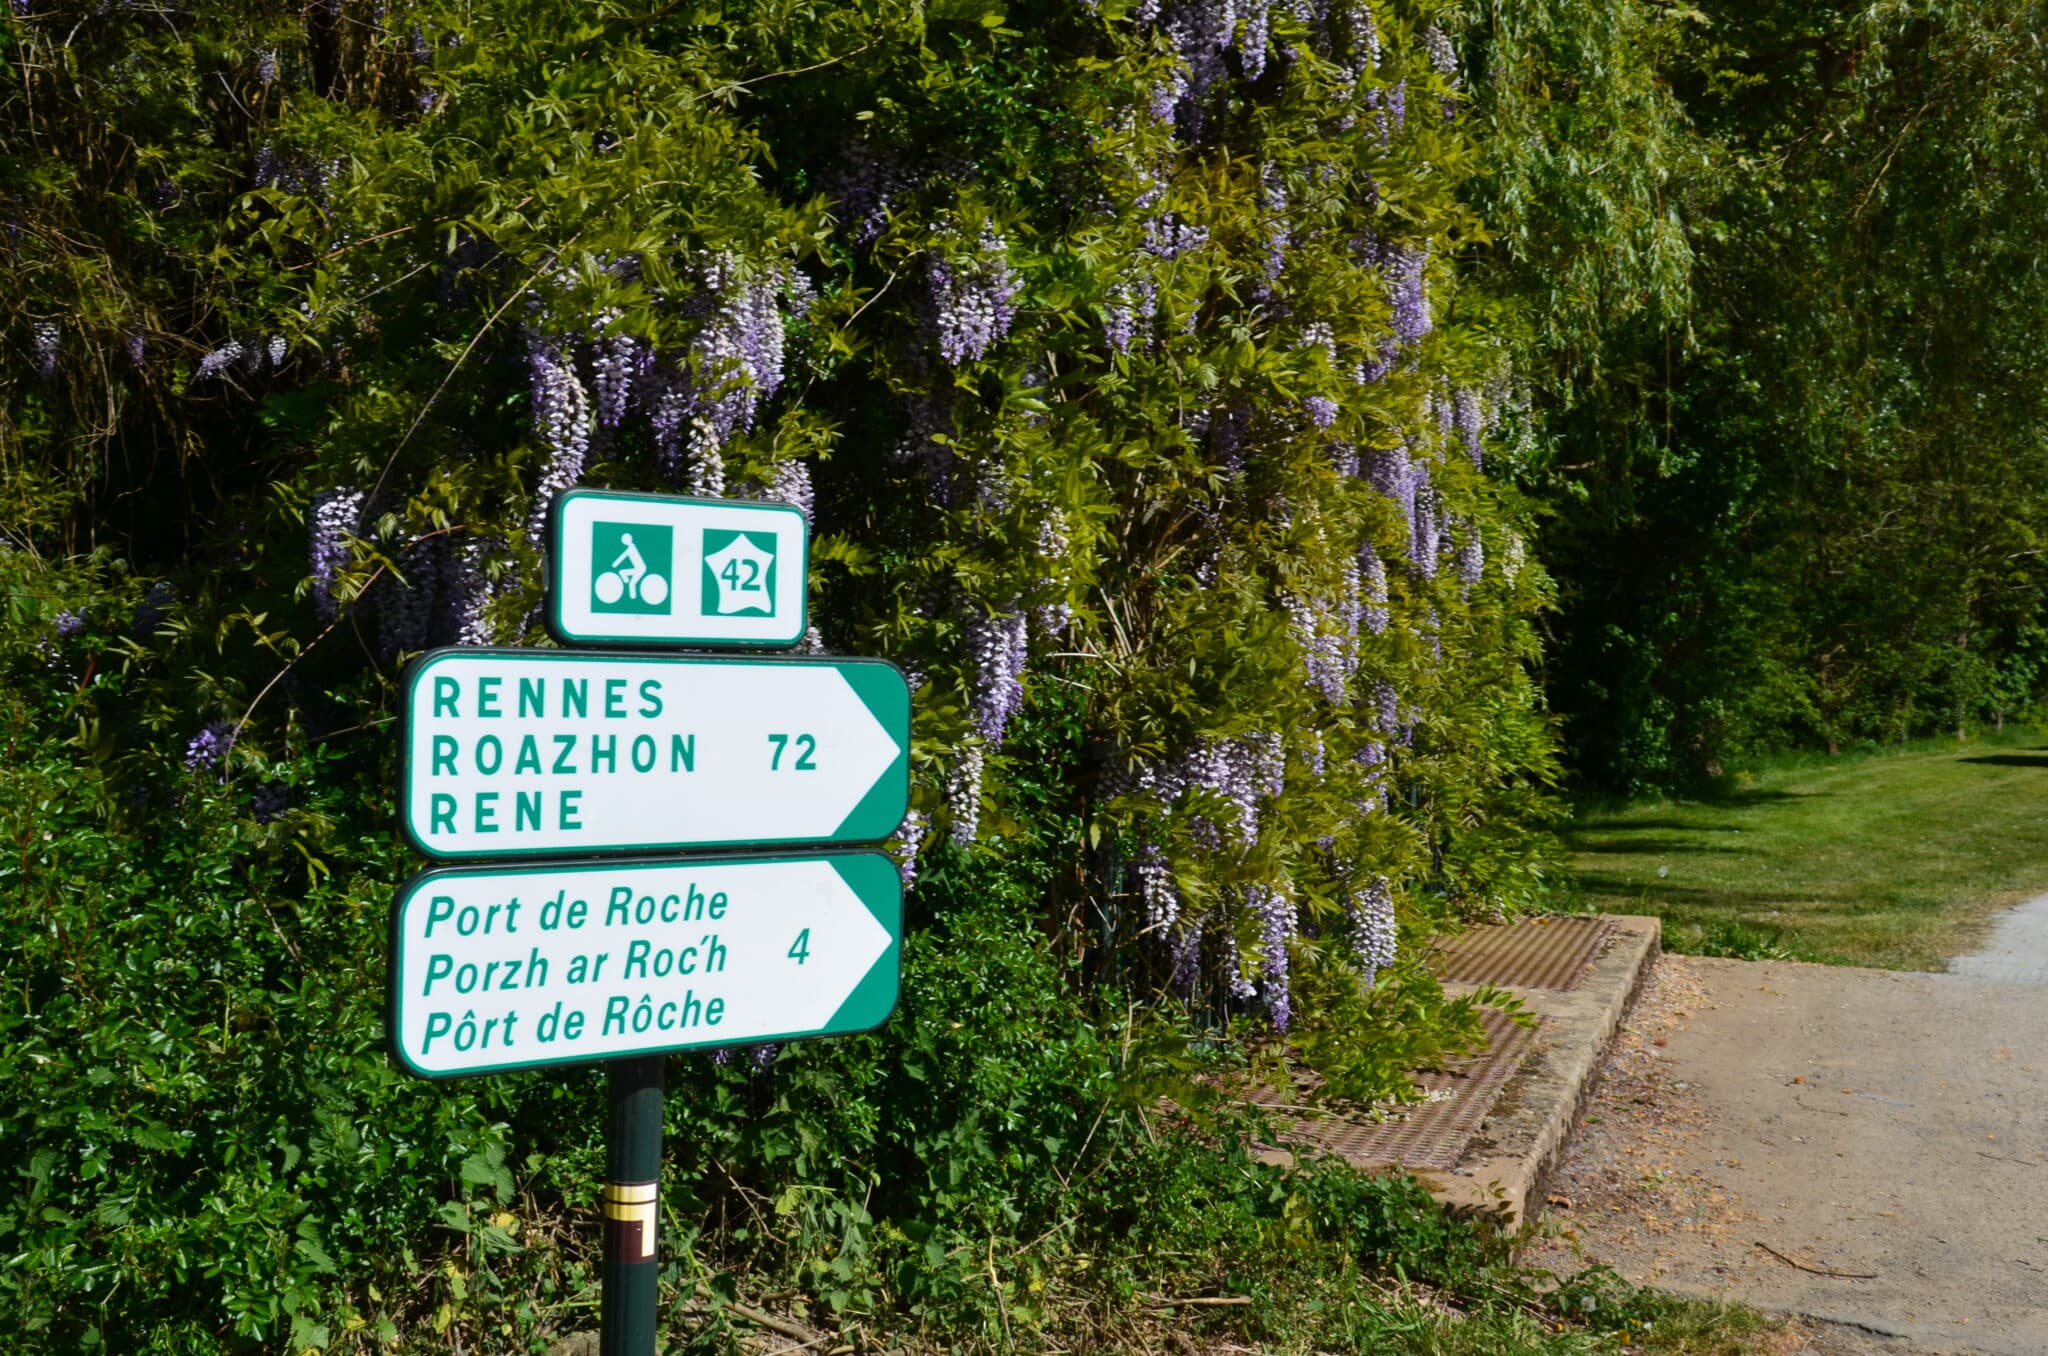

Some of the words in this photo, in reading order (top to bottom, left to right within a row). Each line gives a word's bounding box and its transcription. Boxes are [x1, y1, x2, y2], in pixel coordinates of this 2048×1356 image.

[720, 558, 761, 592] 42
[433, 675, 664, 719] RENNES
[431, 733, 696, 777] ROAZHON
[767, 733, 817, 771] 72
[430, 789, 583, 835] RENE
[423, 895, 522, 939] Port
[539, 889, 588, 931] de
[604, 882, 729, 927] Roche
[422, 946, 549, 997] Porzh
[566, 952, 609, 985] ar
[623, 934, 727, 980] Roc'h
[787, 927, 811, 965] 4
[421, 1008, 519, 1056] Pôrt
[536, 1000, 585, 1044] de
[601, 989, 725, 1037] Rôche
